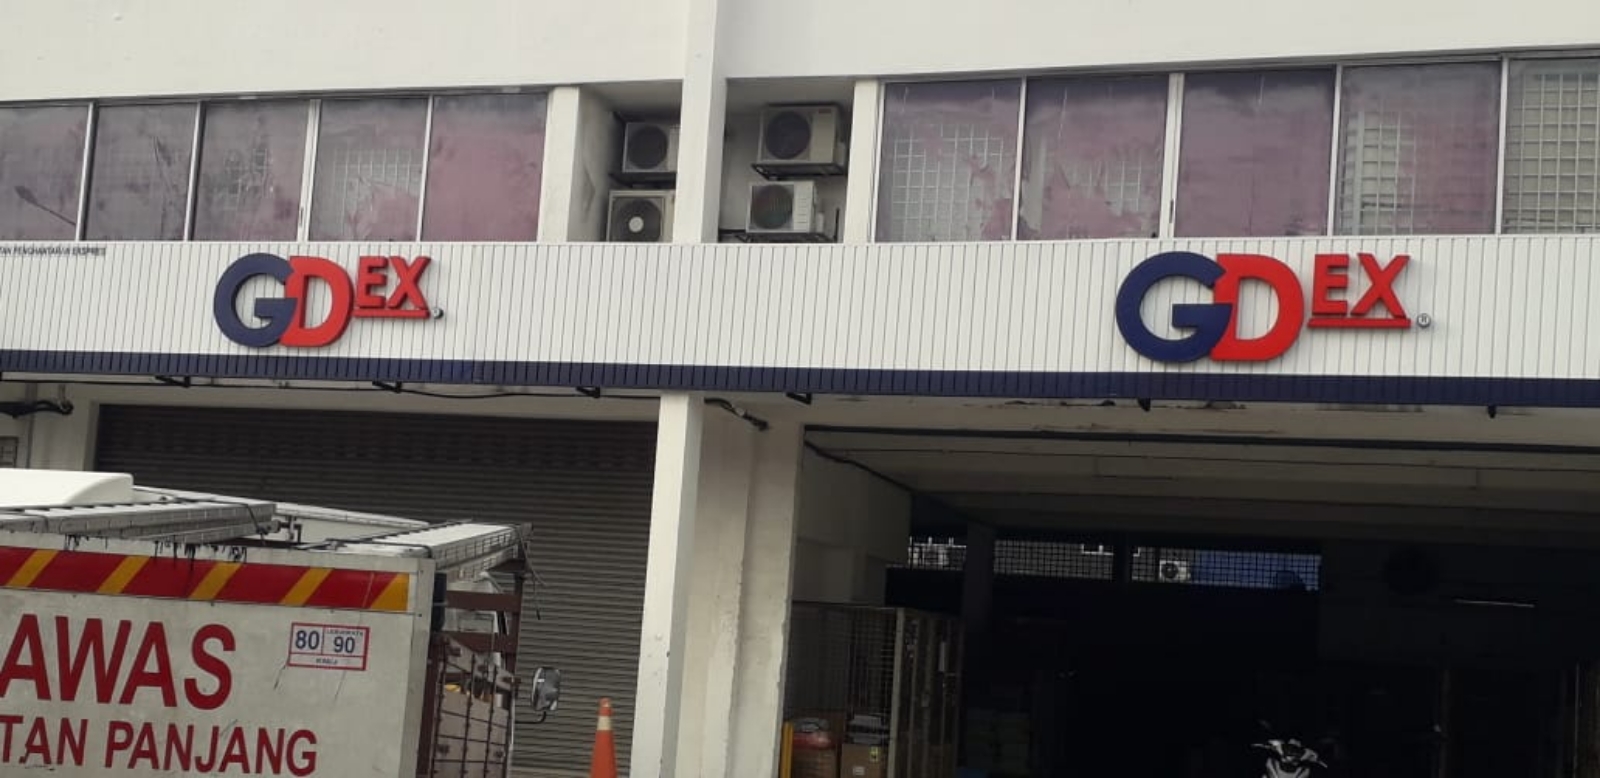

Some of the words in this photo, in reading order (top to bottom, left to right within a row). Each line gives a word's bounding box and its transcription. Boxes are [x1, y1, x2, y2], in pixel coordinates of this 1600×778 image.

[295, 629, 320, 650] 80
[333, 636, 356, 654] 90
[0, 613, 237, 710] AWAS
[105, 720, 318, 777] PANJANG
